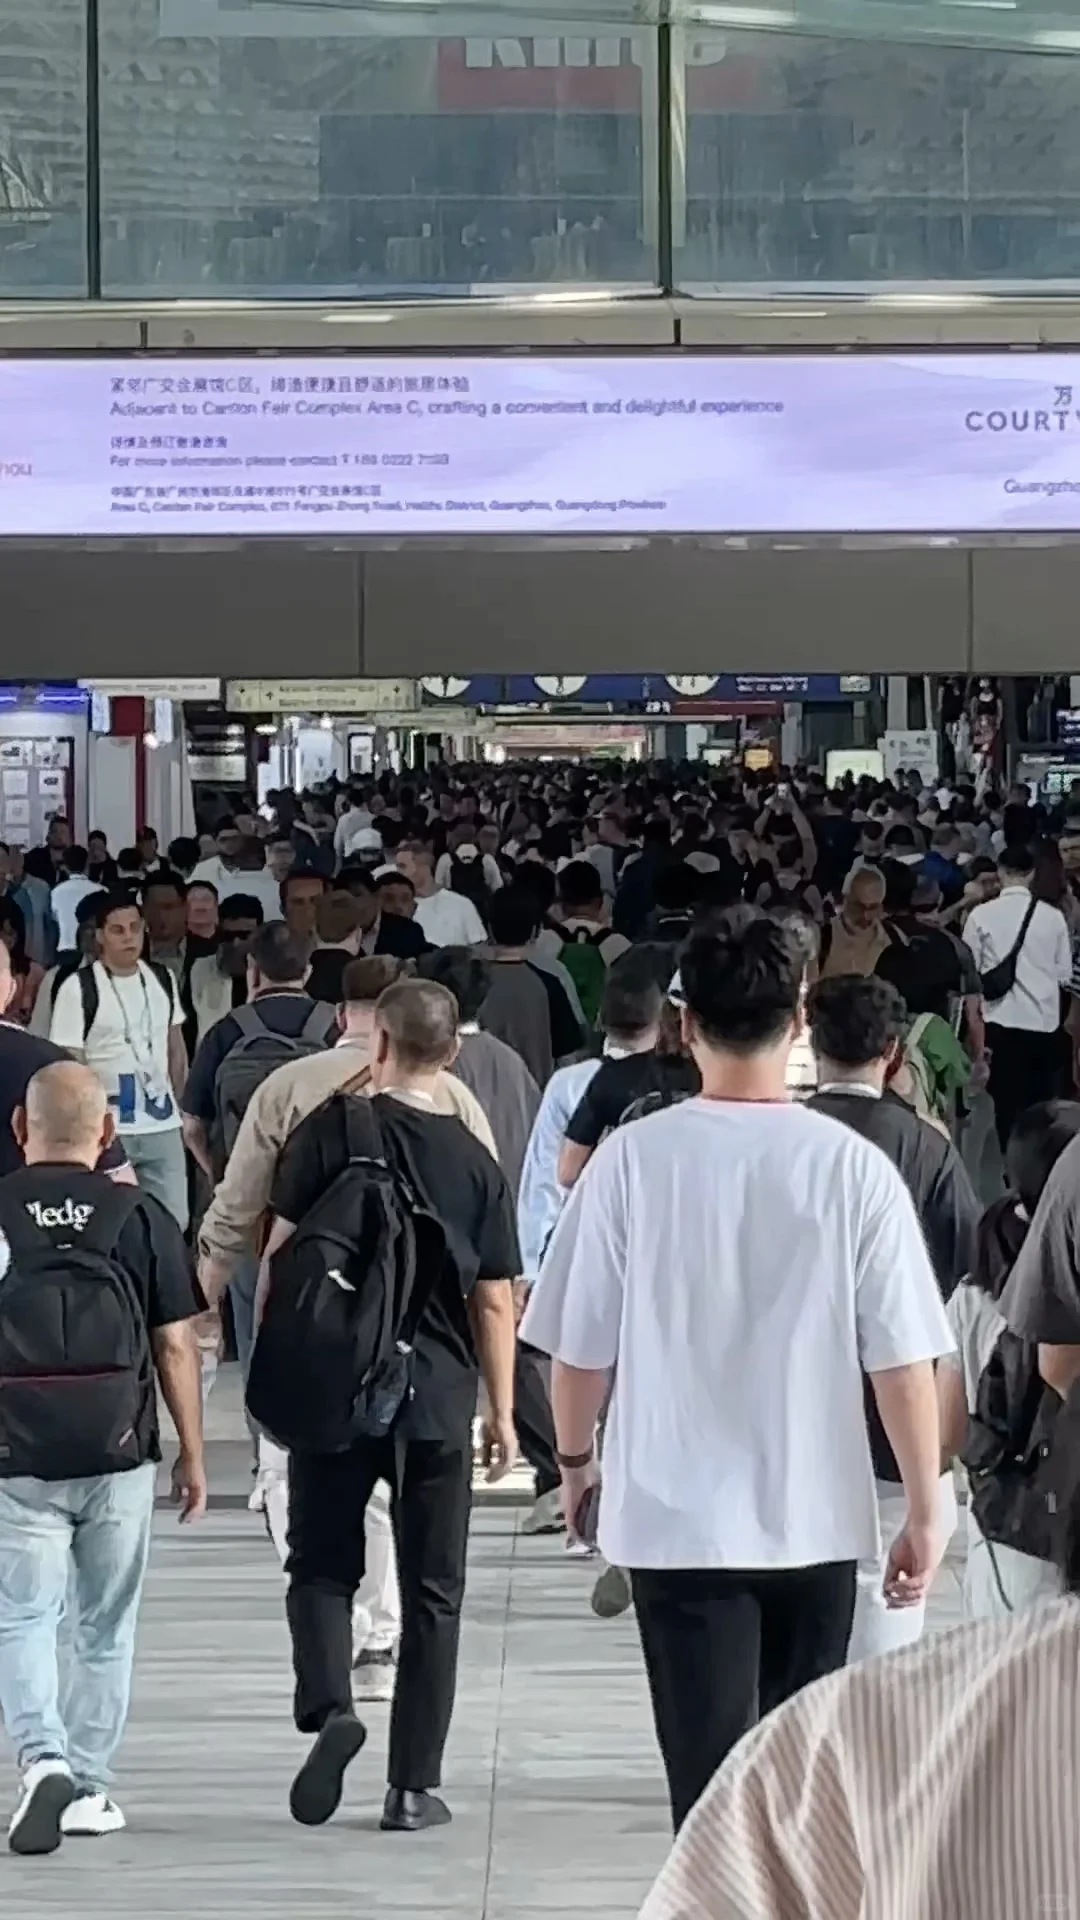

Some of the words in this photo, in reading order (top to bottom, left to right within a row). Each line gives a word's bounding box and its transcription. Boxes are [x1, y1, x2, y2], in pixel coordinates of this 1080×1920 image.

[110, 401, 177, 418] Adjacent
[181, 403, 198, 415] to
[202, 400, 258, 416] Canton
[262, 400, 290, 415] Fair
[295, 400, 362, 417] Complex
[367, 400, 402, 415] Area
[406, 400, 423, 417] C,
[428, 400, 487, 418] crafting
[492, 402, 501, 415] a
[593, 398, 621, 415] and
[625, 398, 696, 417] delightful
[700, 401, 784, 416] experience
[965, 409, 1080, 432] COURT
